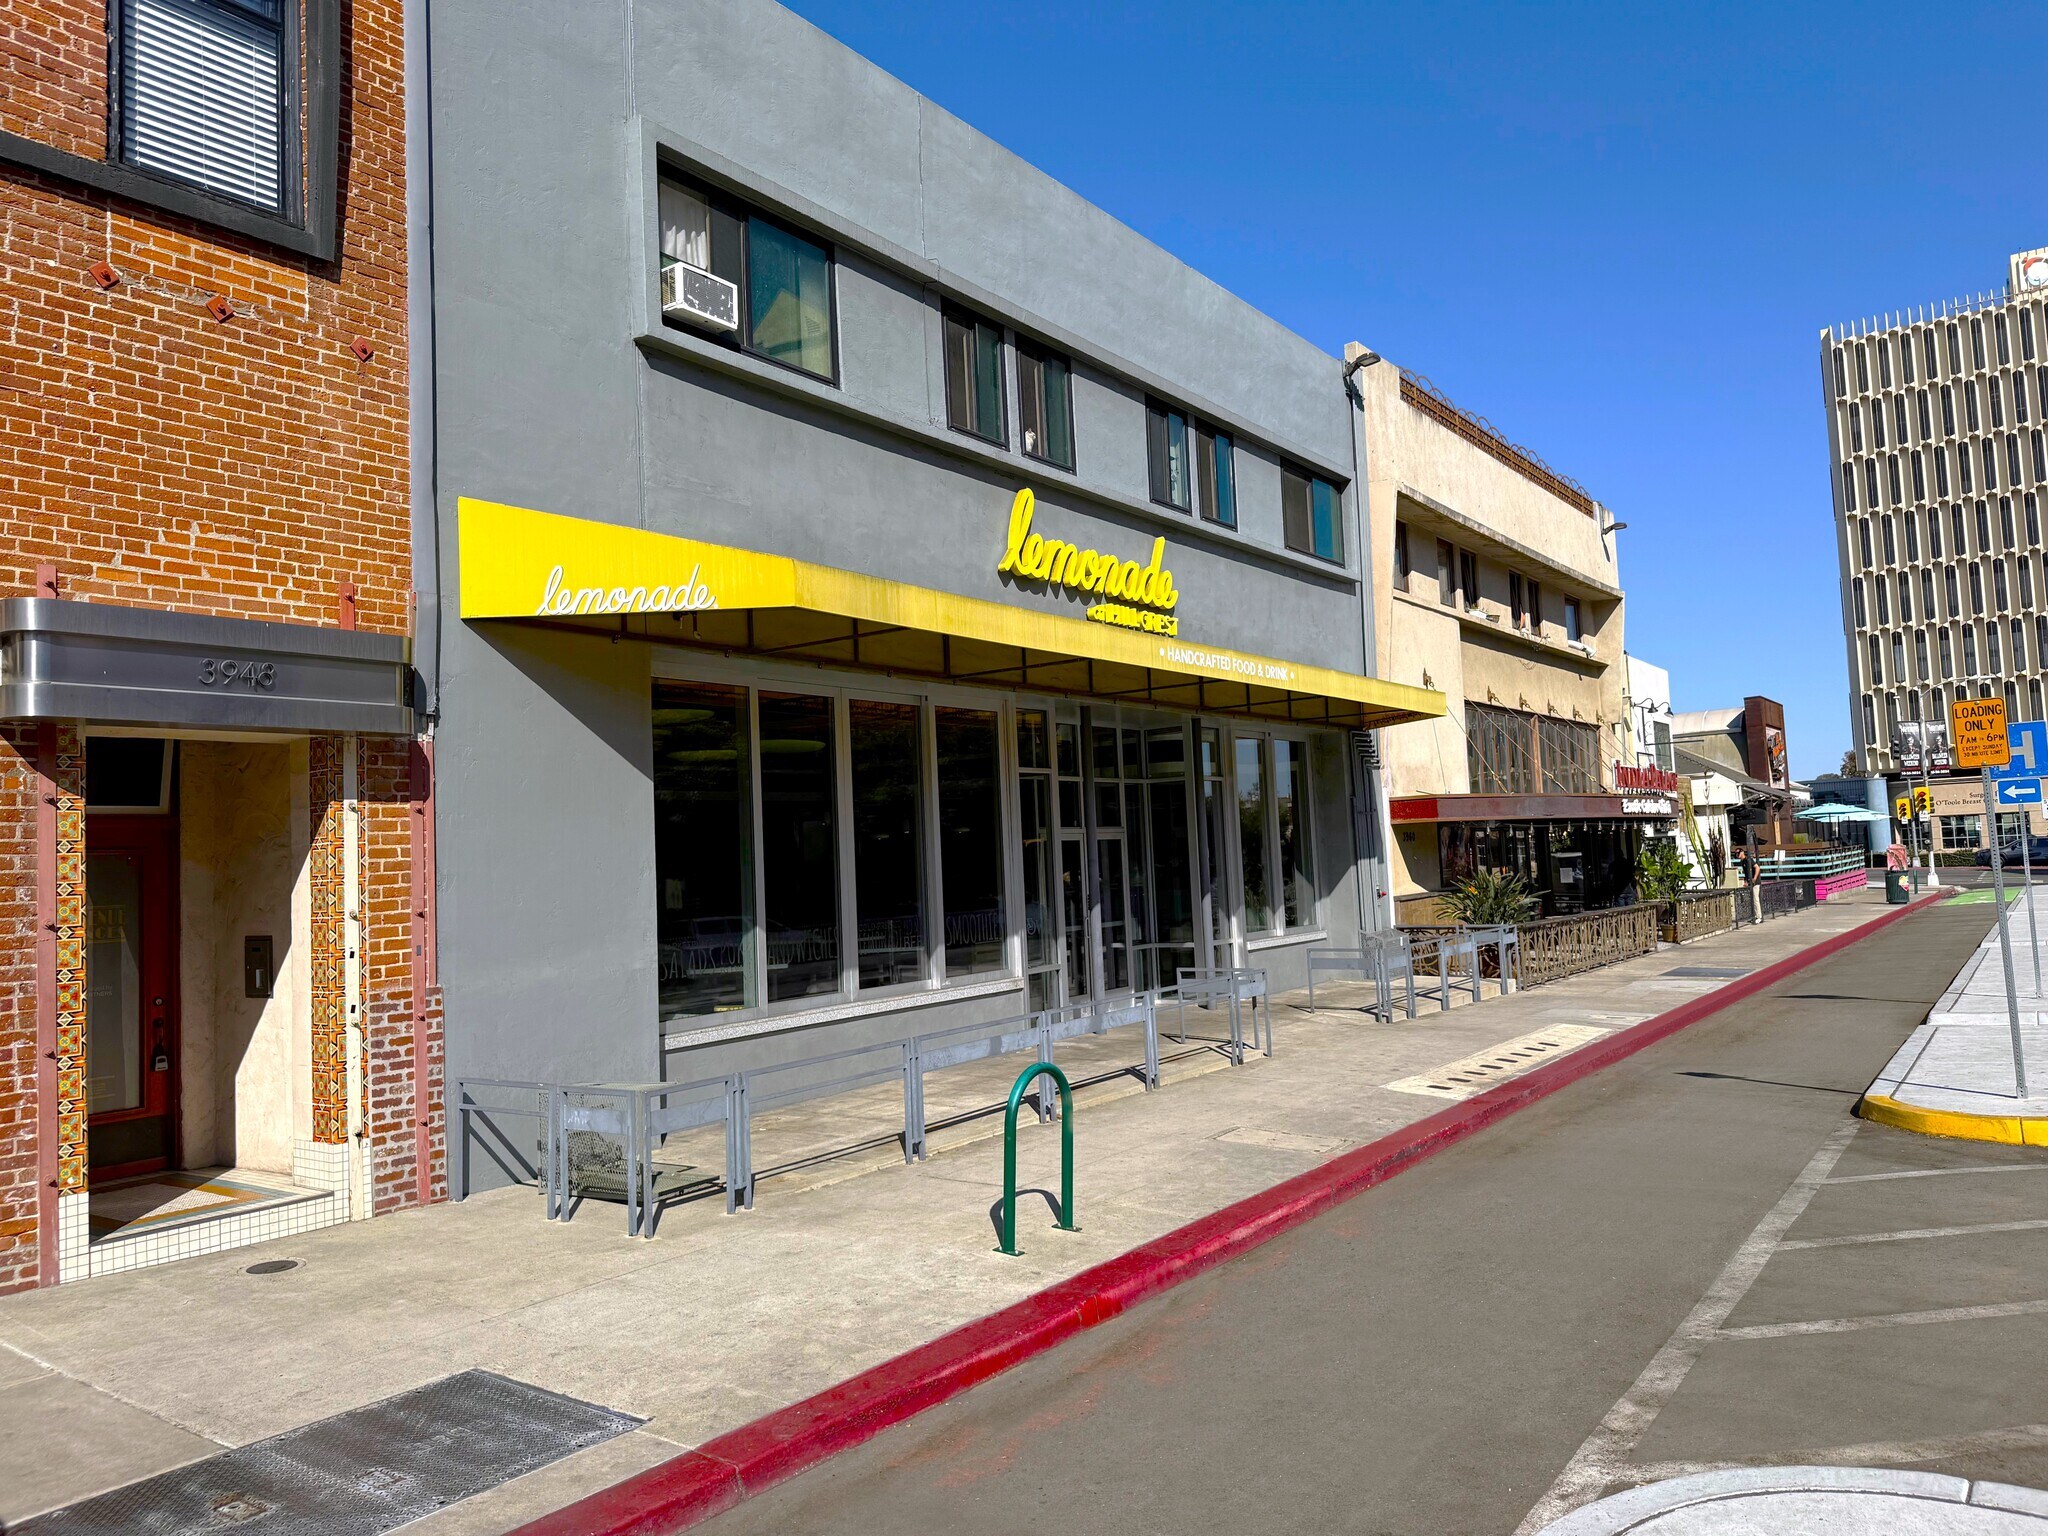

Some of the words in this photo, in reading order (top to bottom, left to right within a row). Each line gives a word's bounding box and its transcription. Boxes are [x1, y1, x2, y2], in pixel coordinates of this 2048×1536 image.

[998, 487, 1179, 610] lemonade
[536, 563, 717, 616] lemonade
[198, 657, 277, 690] 3948
[1167, 646, 1231, 671] HANDCRAFTED
[1233, 658, 1256, 676] FOOD
[1257, 664, 1264, 677] &
[1265, 665, 1289, 680] DRINK
[1954, 704, 2002, 719] LOADING
[1964, 718, 1994, 732] ONLY
